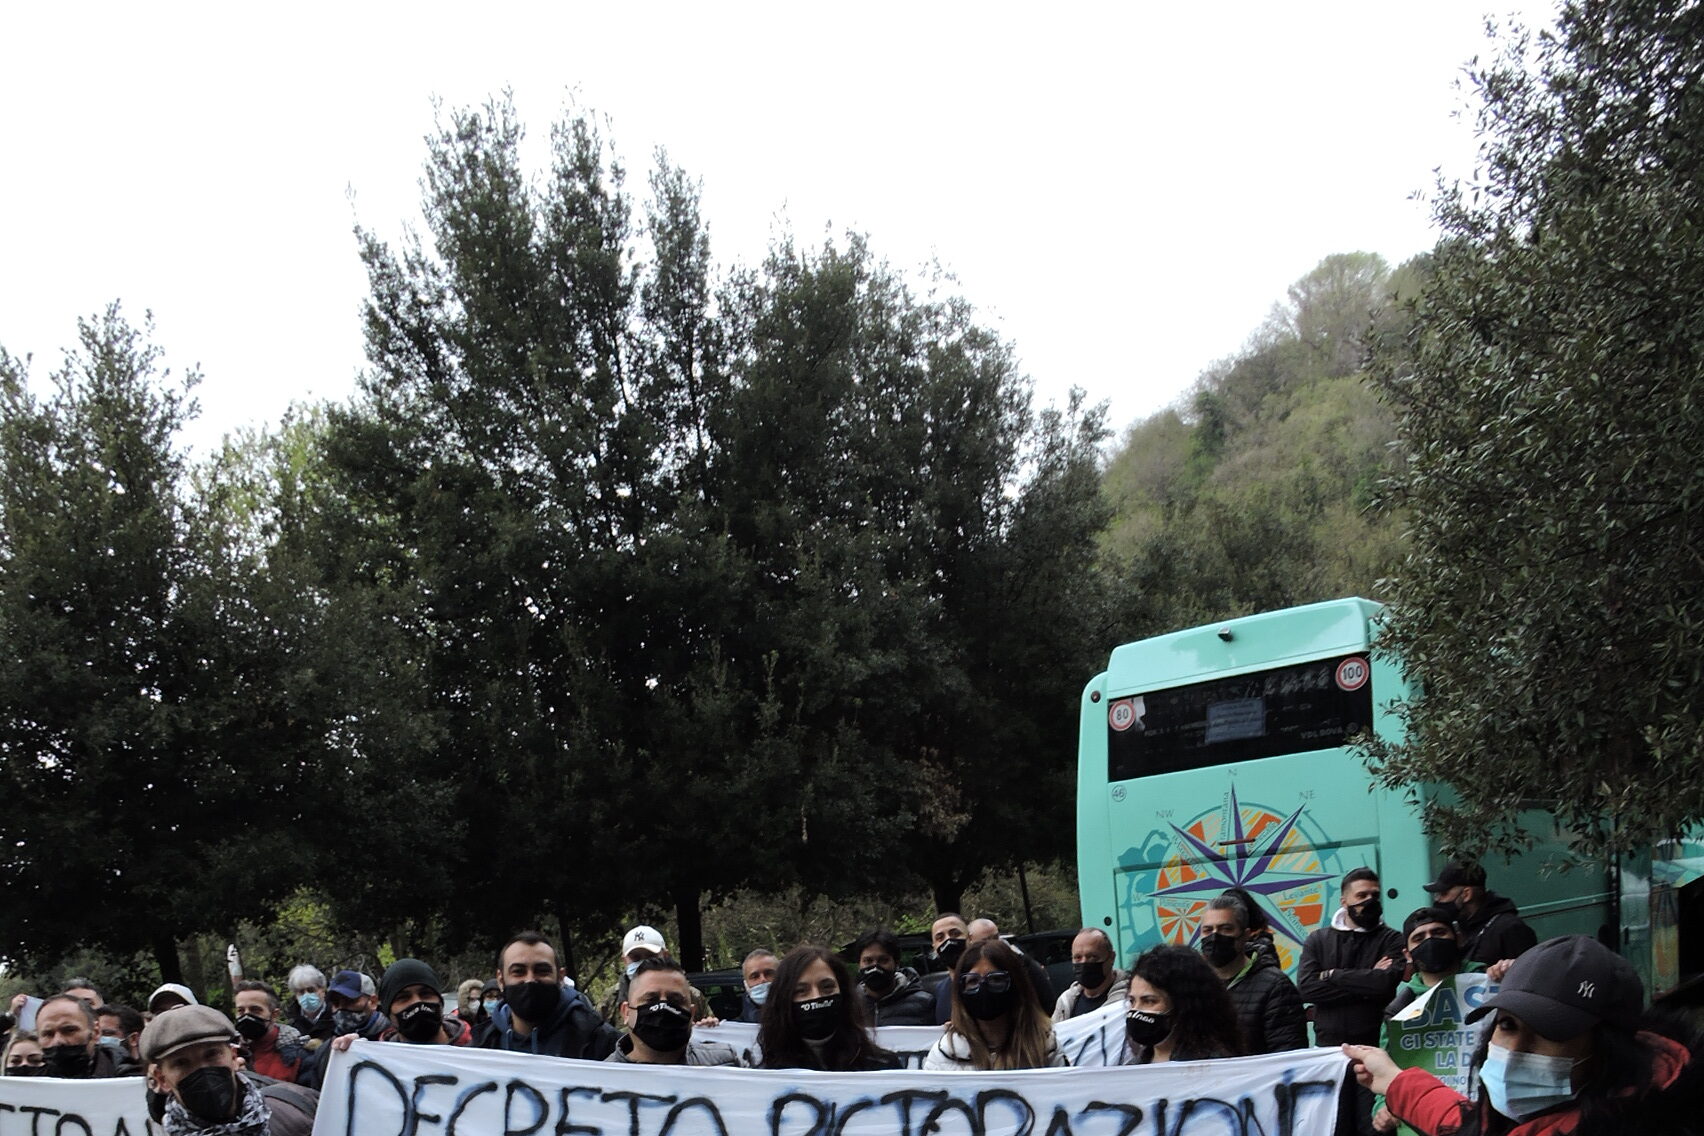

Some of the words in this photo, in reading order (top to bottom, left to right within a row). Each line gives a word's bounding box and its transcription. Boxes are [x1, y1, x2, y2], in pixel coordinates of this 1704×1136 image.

[1343, 665, 1363, 680] 100
[1116, 708, 1129, 721] 80
[1299, 790, 1315, 800] NE
[1156, 810, 1174, 819] NW
[1577, 980, 1595, 998] NY
[1401, 1034, 1420, 1050] CI
[1424, 1030, 1475, 1048] STATE
[1436, 1051, 1457, 1069] LA
